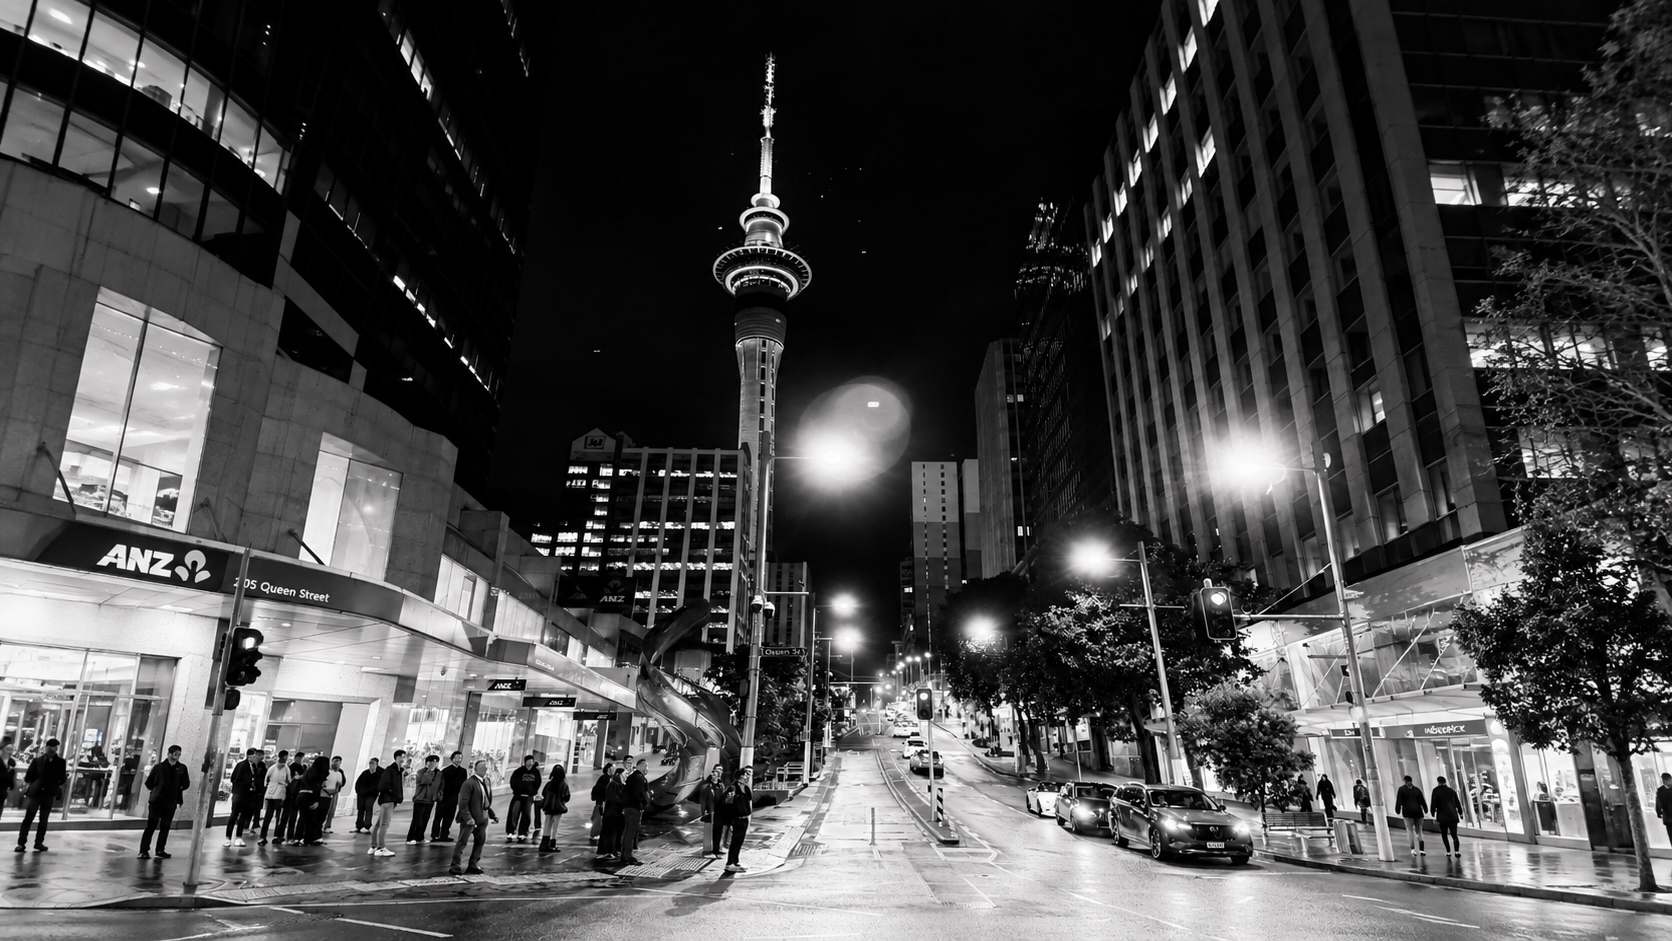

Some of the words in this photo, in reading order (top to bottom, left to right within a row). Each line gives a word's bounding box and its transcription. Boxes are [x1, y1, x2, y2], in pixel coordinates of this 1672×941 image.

[96, 543, 175, 578] ANZ
[260, 582, 297, 597] Queen
[299, 589, 331, 603] Street
[599, 595, 626, 603] ANZ
